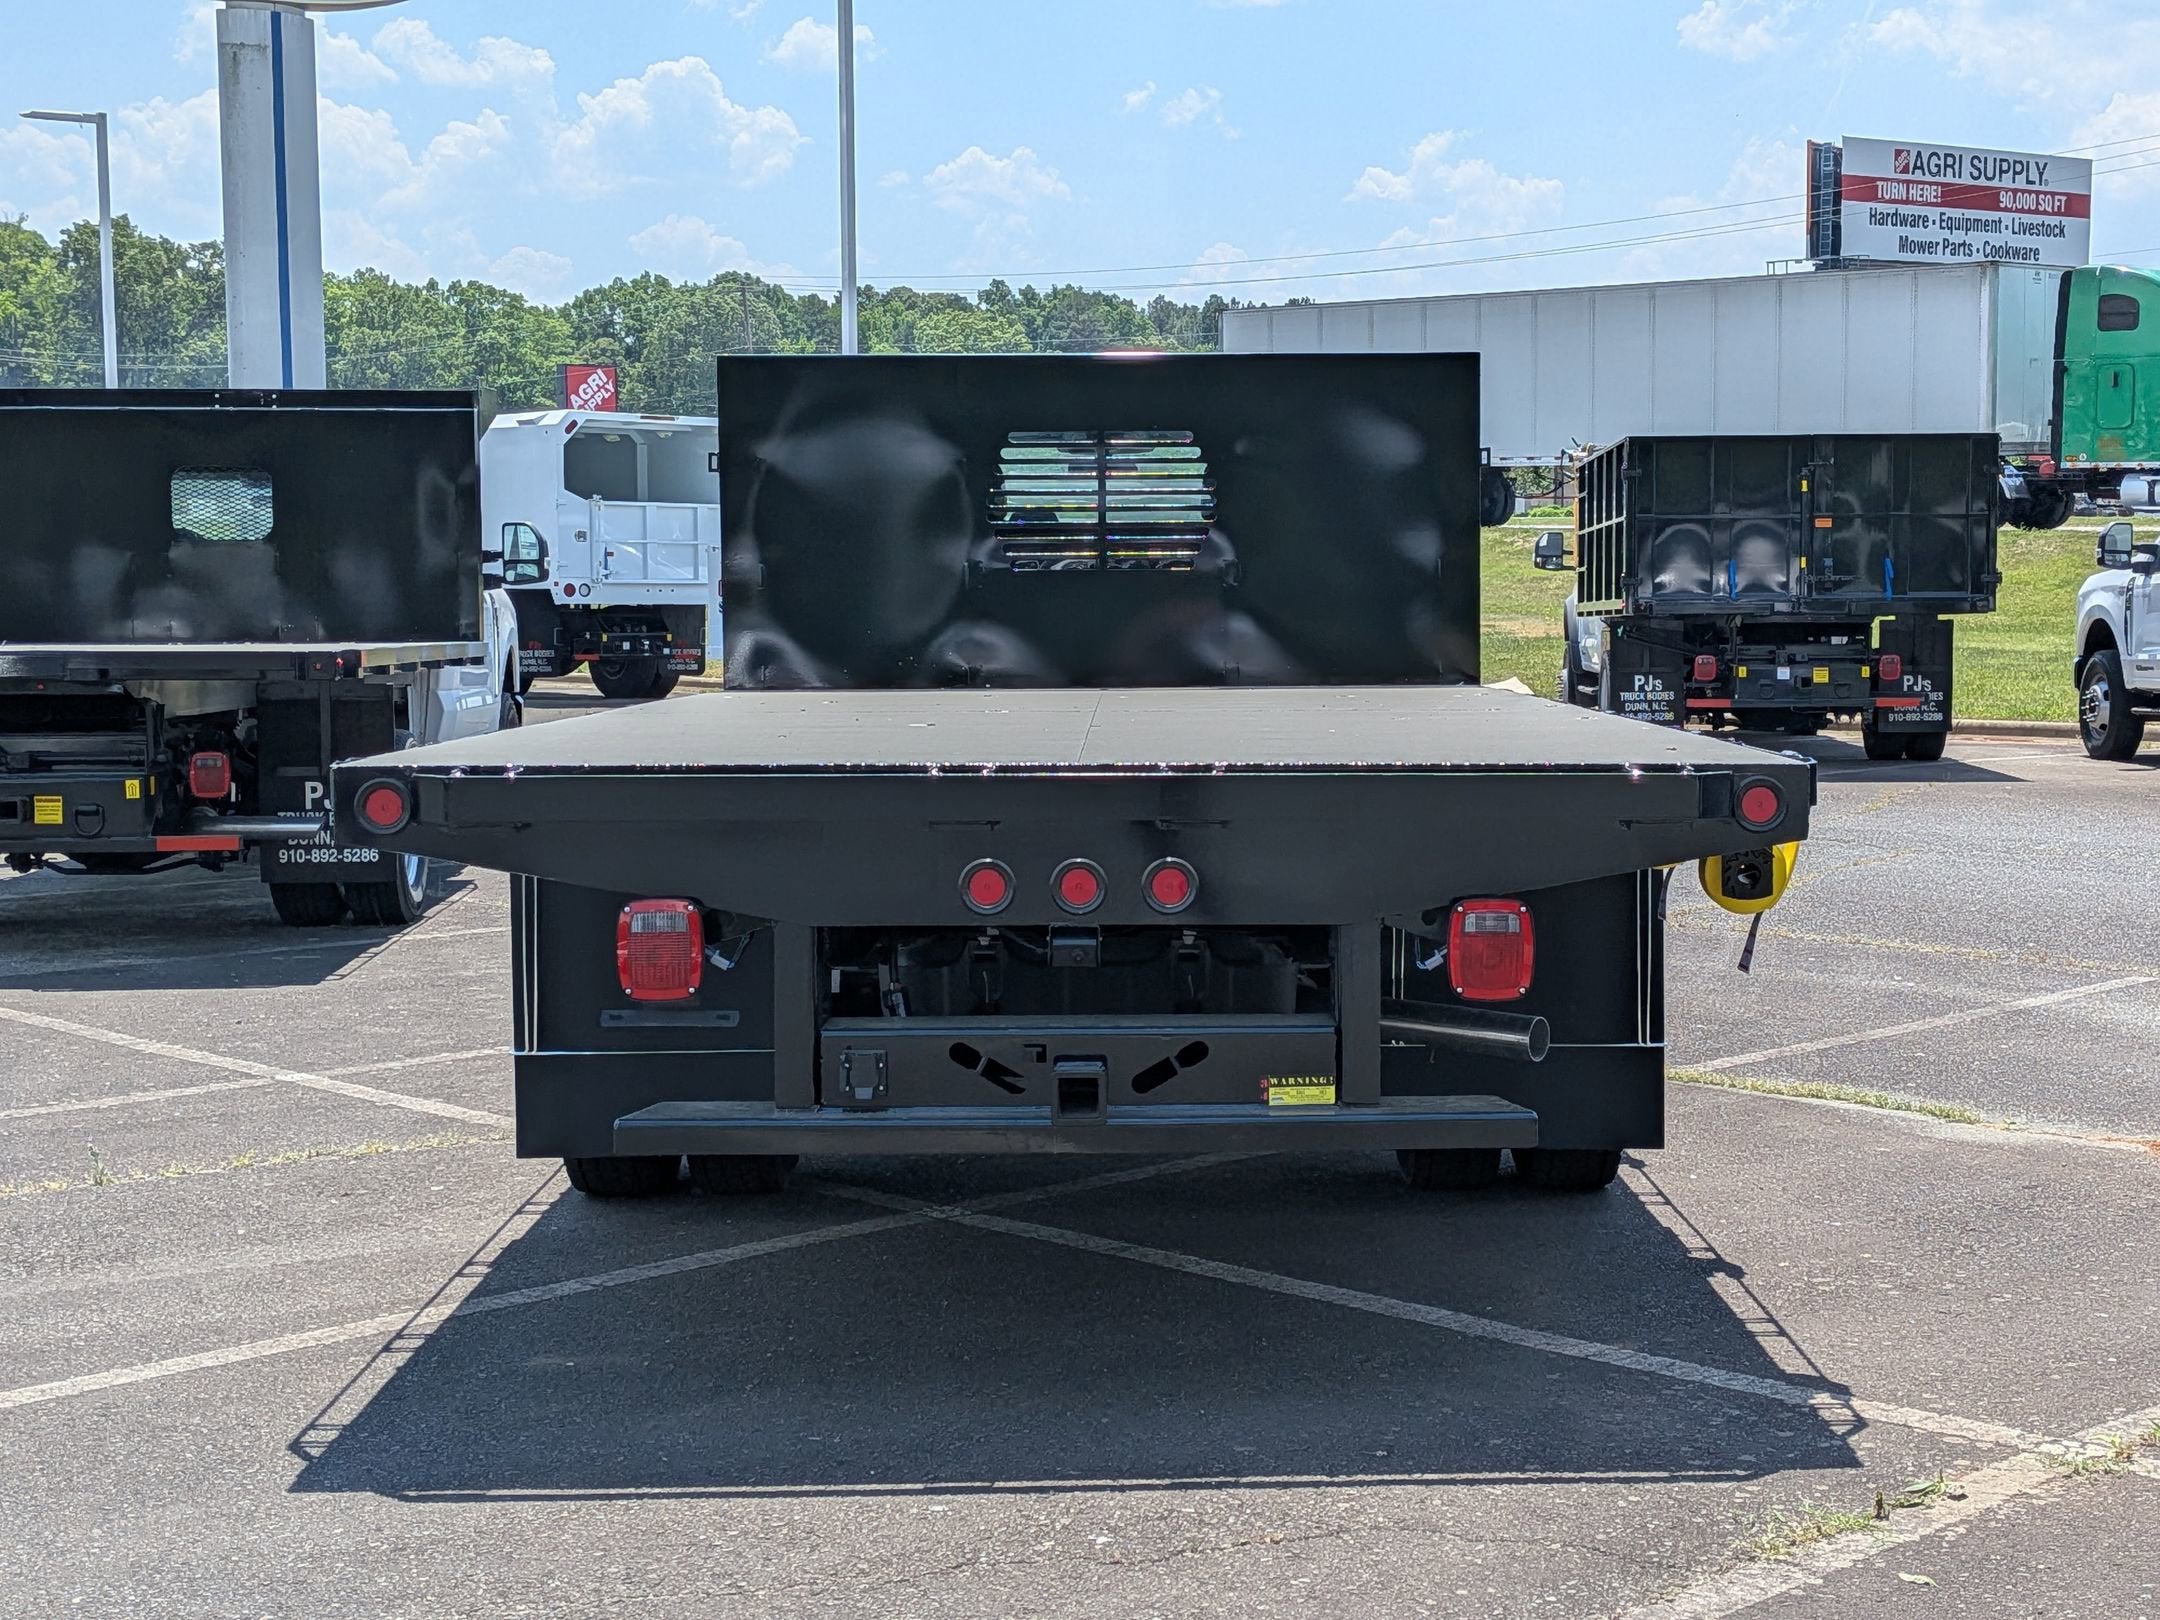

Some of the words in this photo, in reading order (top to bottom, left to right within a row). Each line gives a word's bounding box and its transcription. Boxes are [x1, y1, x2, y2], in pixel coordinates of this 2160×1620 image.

[1911, 150, 1963, 179] AGRI
[1877, 181, 1907, 200] TURN
[1909, 184, 1941, 203] HERE!
[2000, 191, 2036, 212] 90,000
[2038, 194, 2052, 212] SQ
[2054, 196, 2067, 213] FT
[1869, 207, 1930, 229] Hardware
[1939, 212, 2002, 236] Equipment
[2011, 217, 2066, 239] Livestock
[1899, 235, 1940, 255] Mower
[1942, 238, 1974, 258] Parts
[1983, 241, 2040, 261] Cookware
[570, 368, 608, 410] AGRI
[582, 378, 615, 412] PPLY
[1634, 674, 1663, 692] PJ's
[1903, 674, 1932, 692] PJ's
[1620, 691, 1646, 701] TRUCK
[1647, 691, 1675, 701] BODIES
[278, 848, 380, 863] 910-892-5286
[1269, 1076, 1334, 1086] WARNING!
